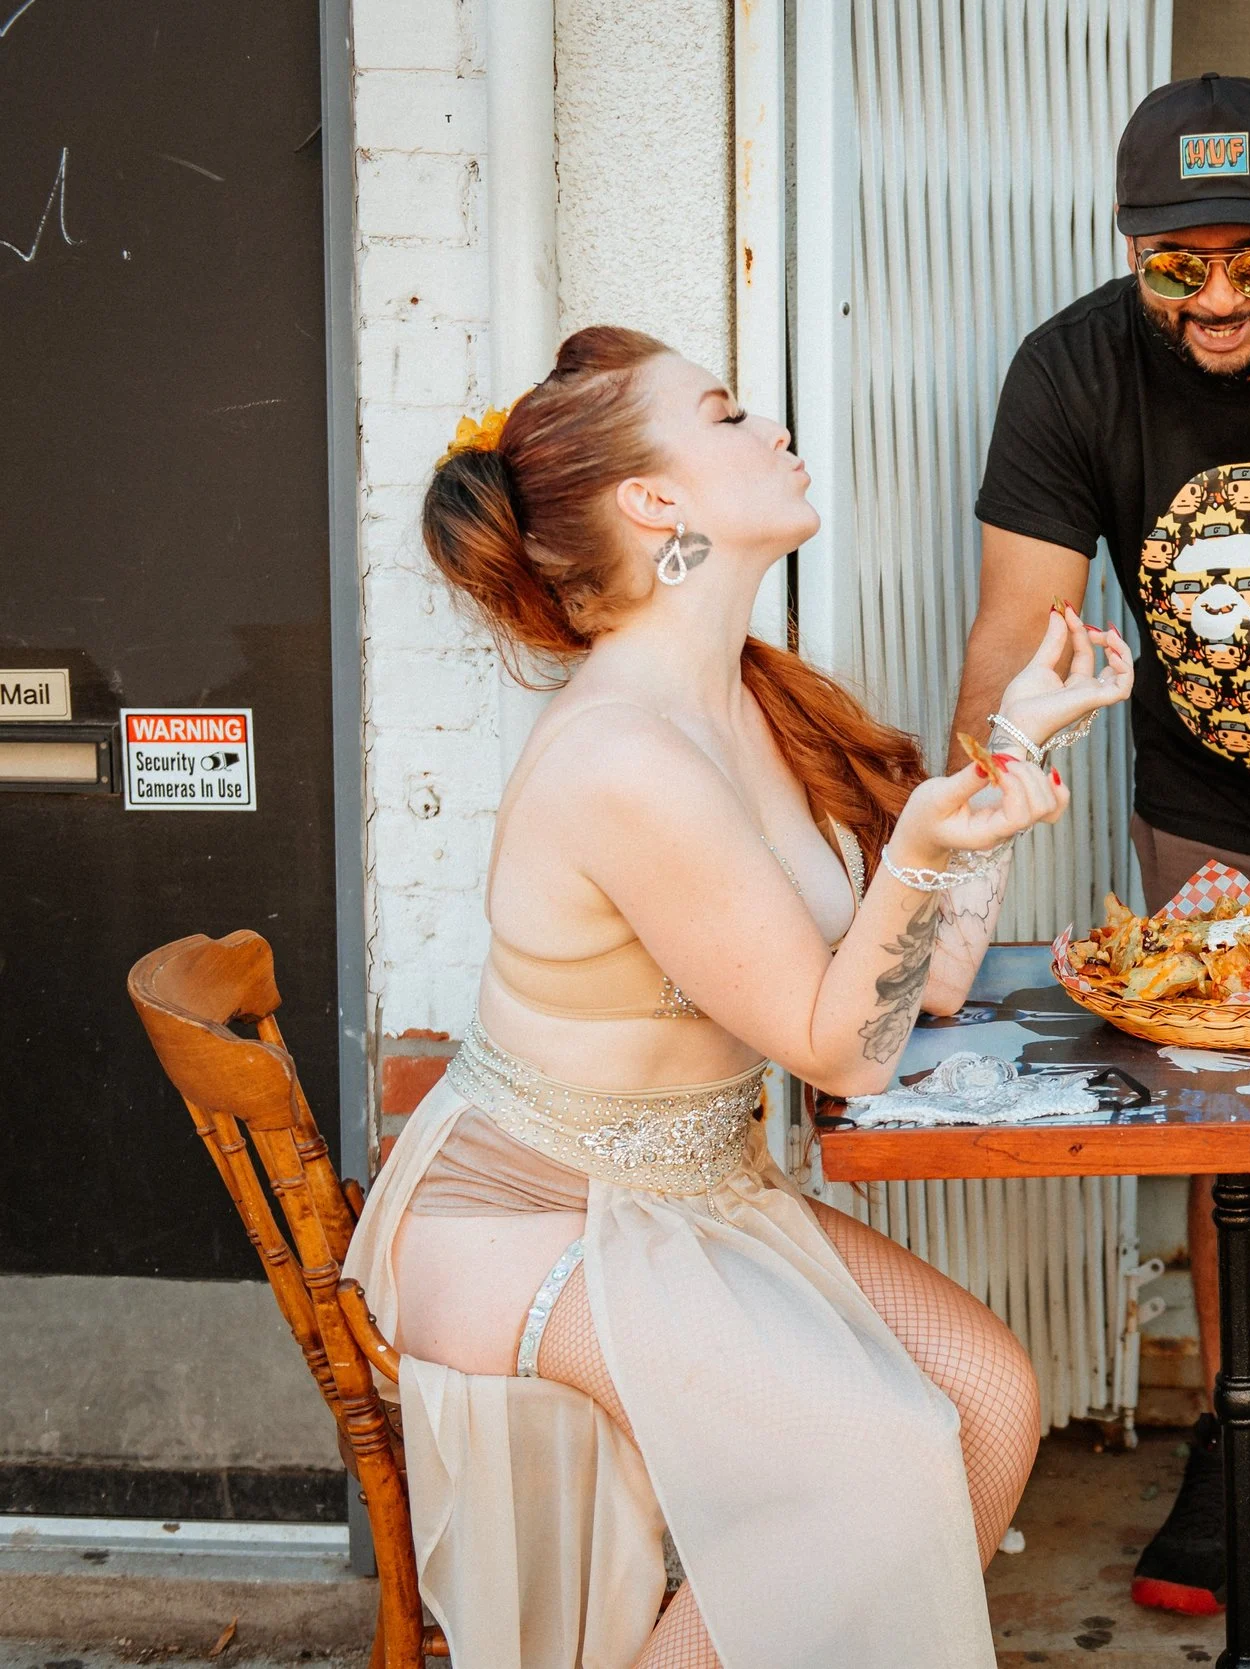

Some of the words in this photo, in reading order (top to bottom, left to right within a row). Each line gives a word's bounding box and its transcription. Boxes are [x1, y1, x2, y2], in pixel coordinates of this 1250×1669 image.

[1185, 137, 1244, 169] HUF
[1, 683, 50, 705] Mail
[132, 718, 242, 741] WARNING
[136, 751, 195, 776] Security
[137, 778, 196, 798] Cameras
[201, 778, 213, 798] In
[218, 778, 242, 798] Use
